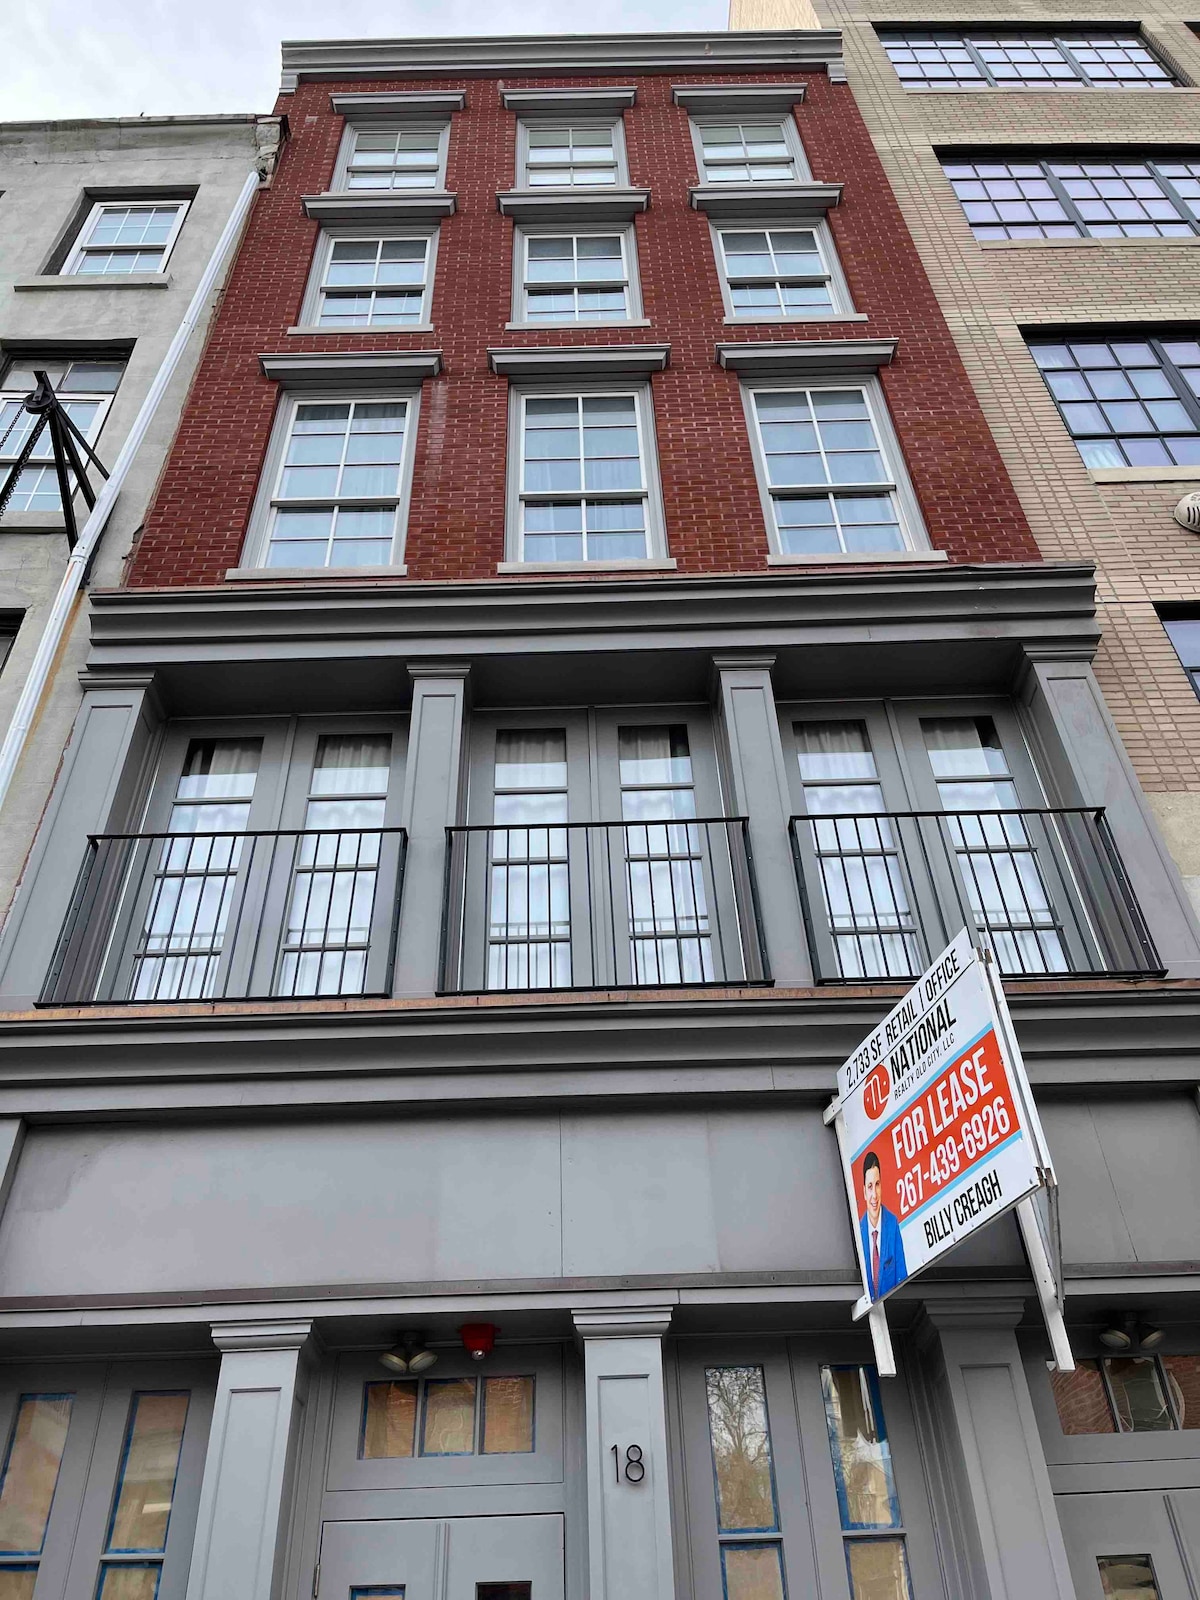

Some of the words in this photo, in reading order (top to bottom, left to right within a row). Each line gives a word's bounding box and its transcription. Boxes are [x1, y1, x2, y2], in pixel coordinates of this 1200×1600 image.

[870, 1033, 882, 1061] SF
[885, 999, 918, 1046] RETAIL
[925, 948, 960, 1002] OFFICE
[889, 997, 957, 1085] NATIONAL
[891, 1105, 929, 1169] FOR
[927, 1046, 994, 1137] LEASE
[894, 1073, 914, 1100] REALTY
[915, 1061, 927, 1079] OLD
[942, 1032, 955, 1051] LLC
[896, 1095, 1011, 1216] 267-439-6926
[923, 1204, 954, 1249] BILLY
[953, 1169, 1003, 1226] CREAGH
[611, 1444, 645, 1483] 18
